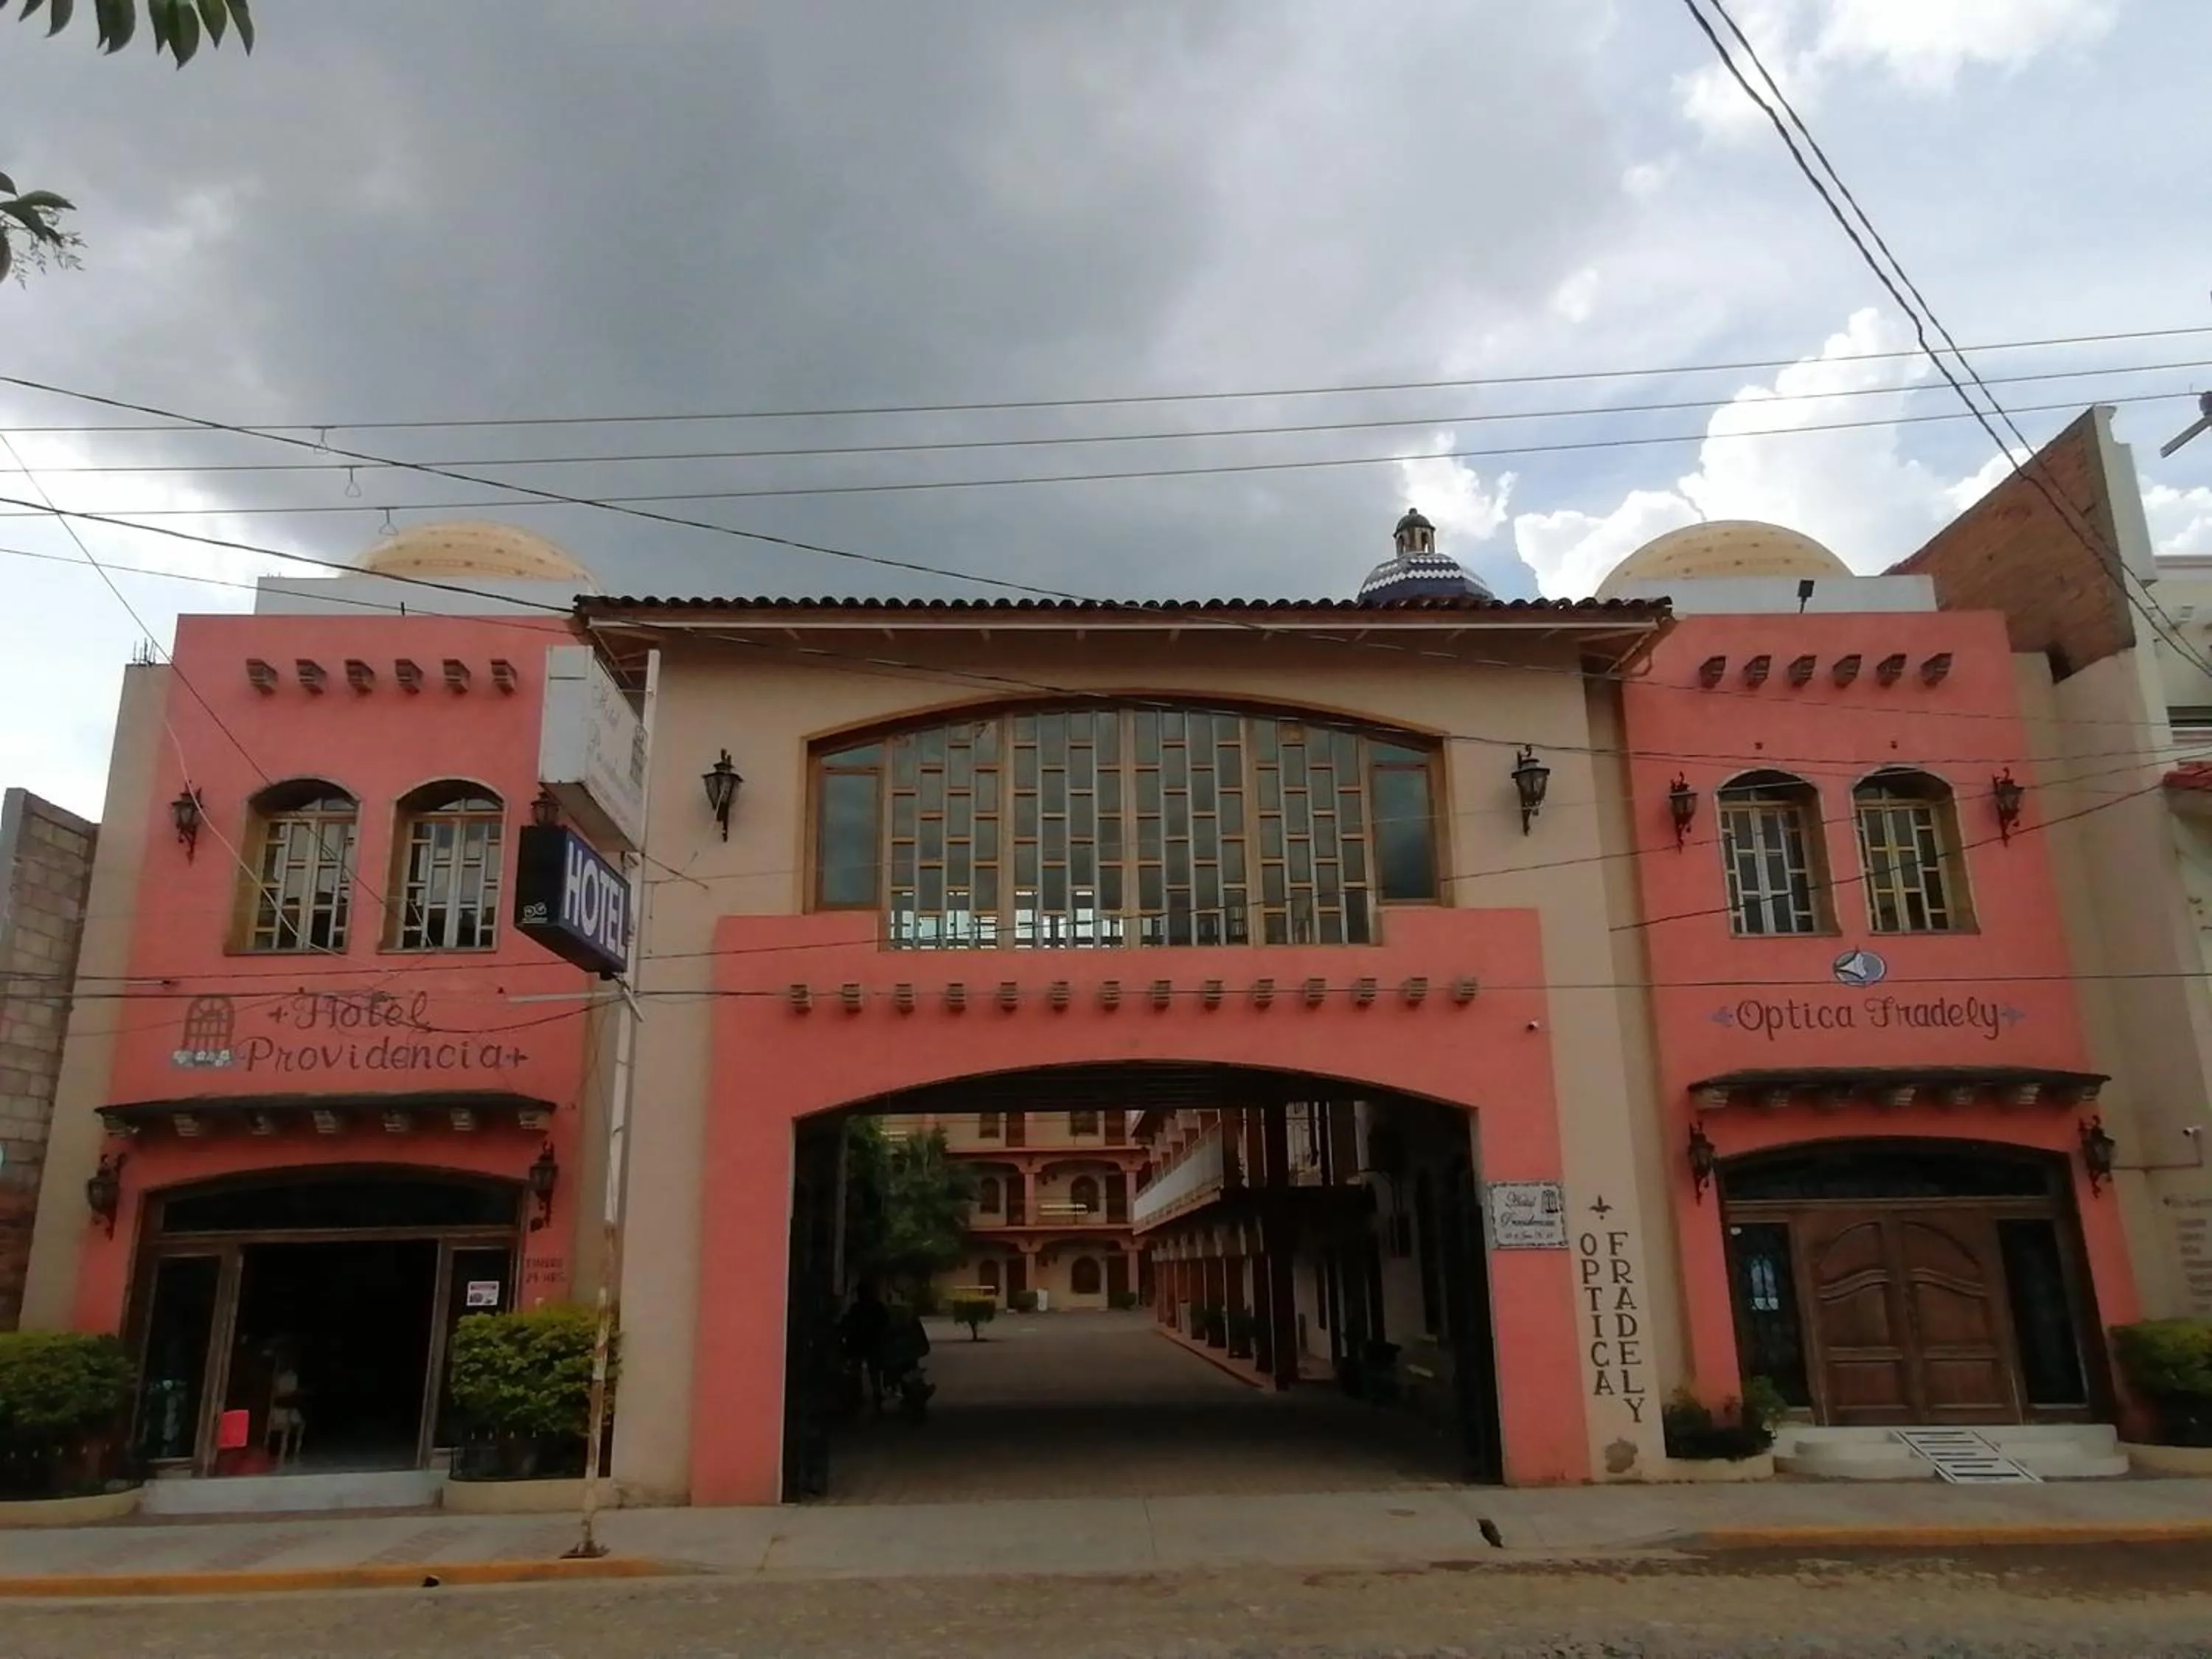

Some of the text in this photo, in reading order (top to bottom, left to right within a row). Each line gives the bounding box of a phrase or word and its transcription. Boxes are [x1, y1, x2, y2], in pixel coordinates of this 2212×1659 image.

[563, 840, 627, 959] HOTEL
[295, 990, 431, 1031] Hotel
[1736, 996, 2001, 1040] Optica Fradely
[242, 1035, 503, 1073] Providencia
[1579, 1232, 1615, 1396] OPTICA
[1606, 1231, 1646, 1424] FRADELY
